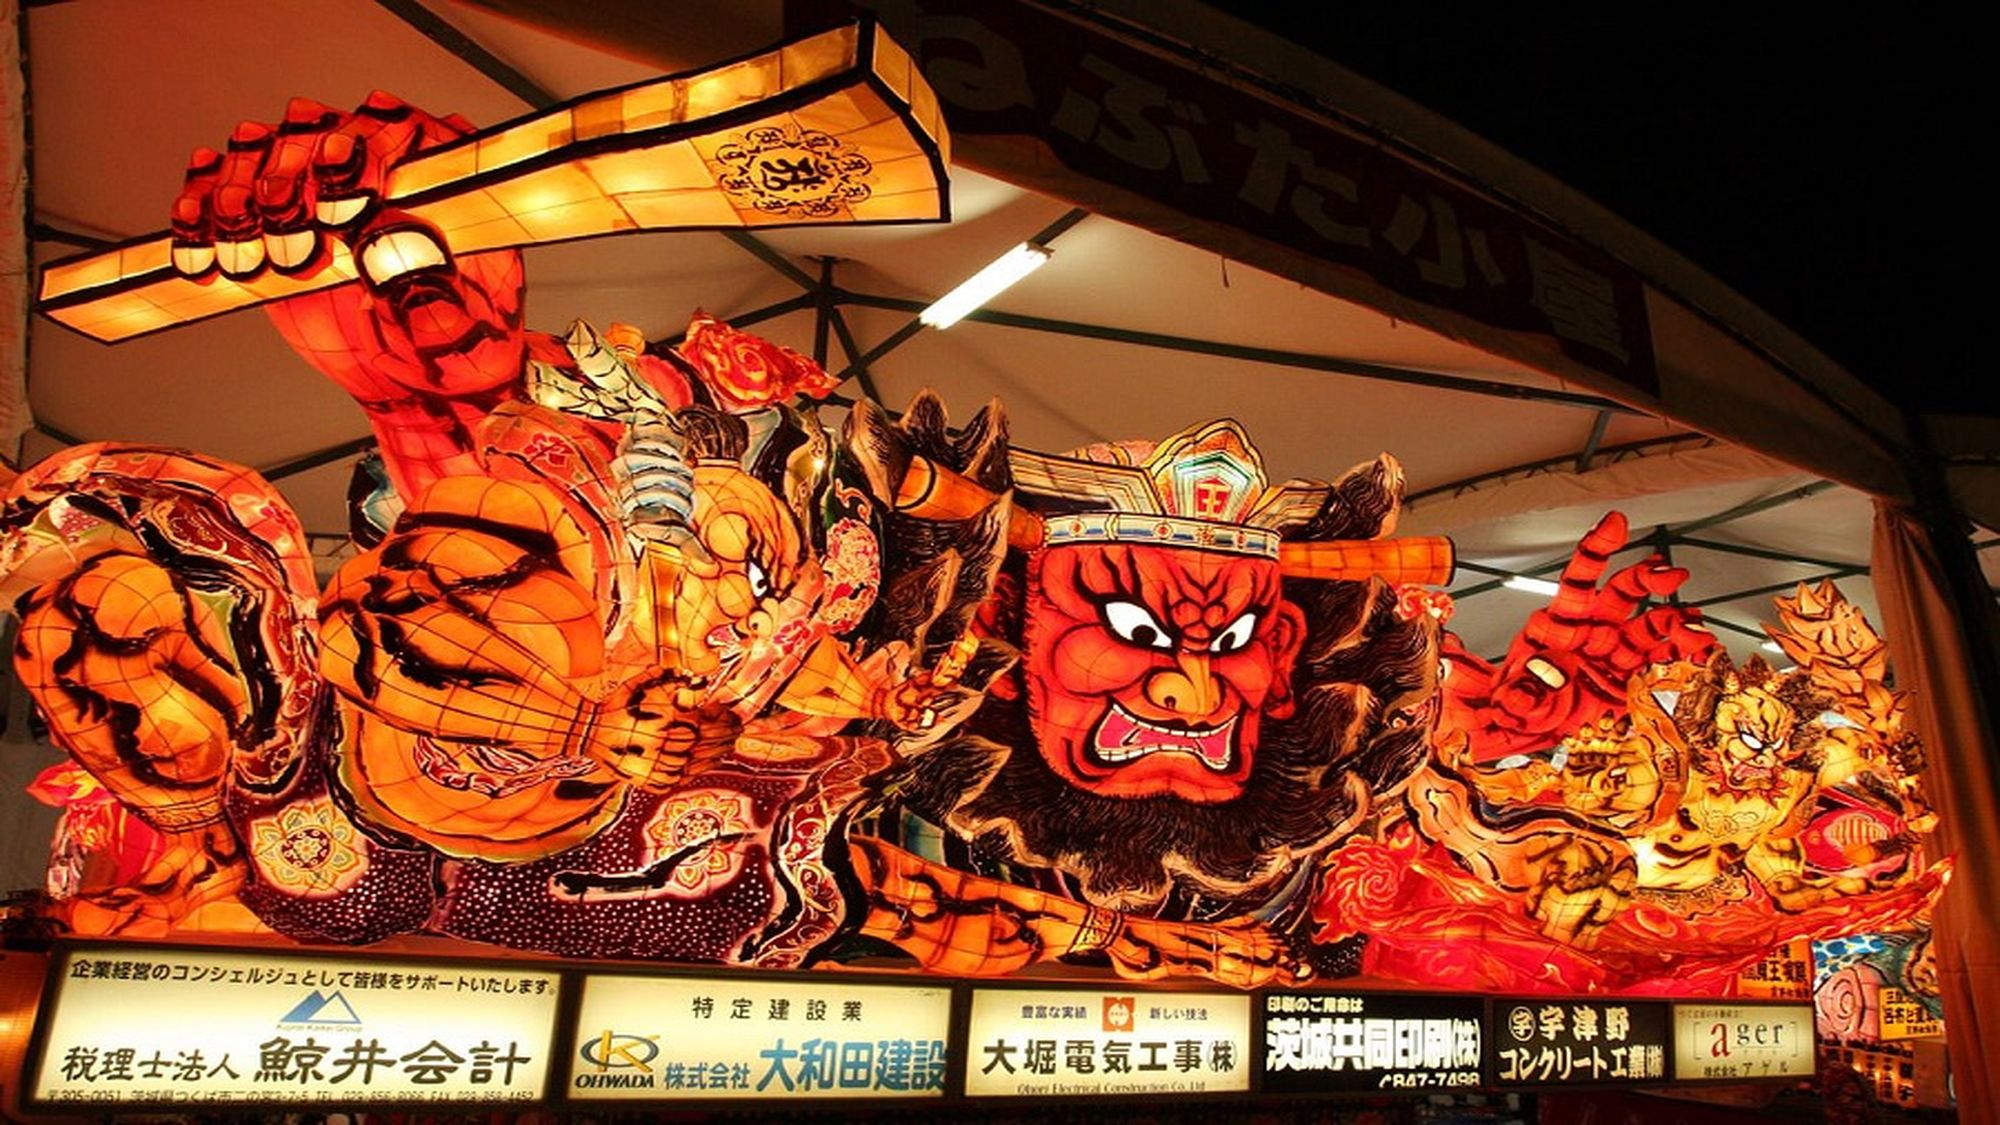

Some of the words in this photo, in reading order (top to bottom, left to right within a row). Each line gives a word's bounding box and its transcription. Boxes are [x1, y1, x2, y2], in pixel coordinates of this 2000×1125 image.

[692, 996, 863, 1022] 特定建設業
[1710, 1020, 1783, 1058] ager
[61, 1046, 240, 1082] 税理士法人
[253, 1036, 532, 1086] 鯨井会計
[663, 1062, 750, 1090] 株式会社
[756, 1038, 948, 1092] 大和田建設
[575, 1073, 655, 1089] OHWADA
